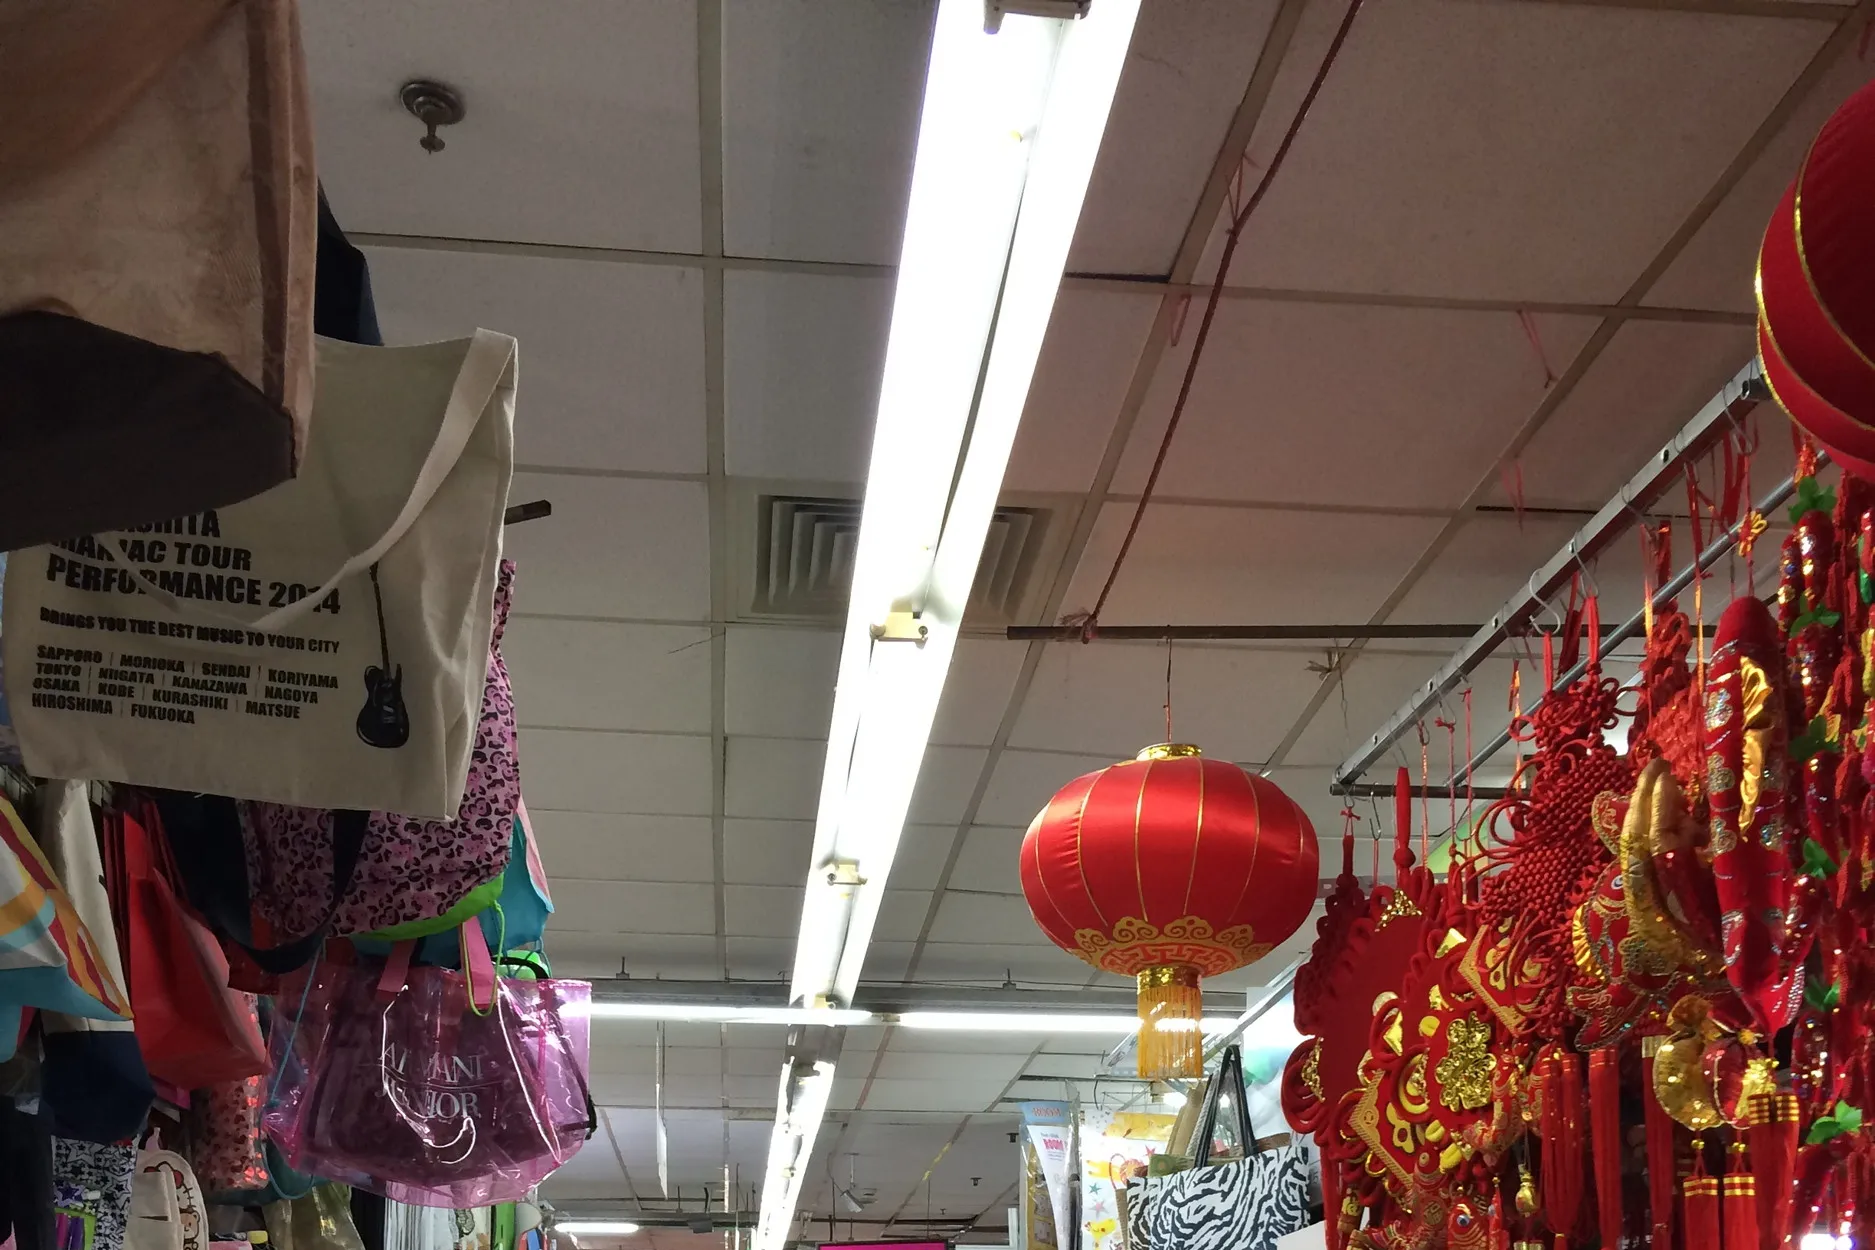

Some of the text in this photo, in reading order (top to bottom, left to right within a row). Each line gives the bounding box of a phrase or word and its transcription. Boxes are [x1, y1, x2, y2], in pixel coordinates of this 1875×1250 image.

[51, 534, 252, 571] ANAC TOUR
[40, 606, 340, 654] BRINGS YOU THE BEST MUSIC TO YOUR CITY
[36, 662, 319, 704] TOKYO NIIGATA KANAZAWA NAGOYA
[37, 645, 339, 690] SAPPORO MORIOKA SENDAI KORIYAMA
[32, 677, 301, 720] OSAKA KOBE KURASHIKI MATSUE
[32, 692, 195, 725] HIROSHIMA FUKUOKA
